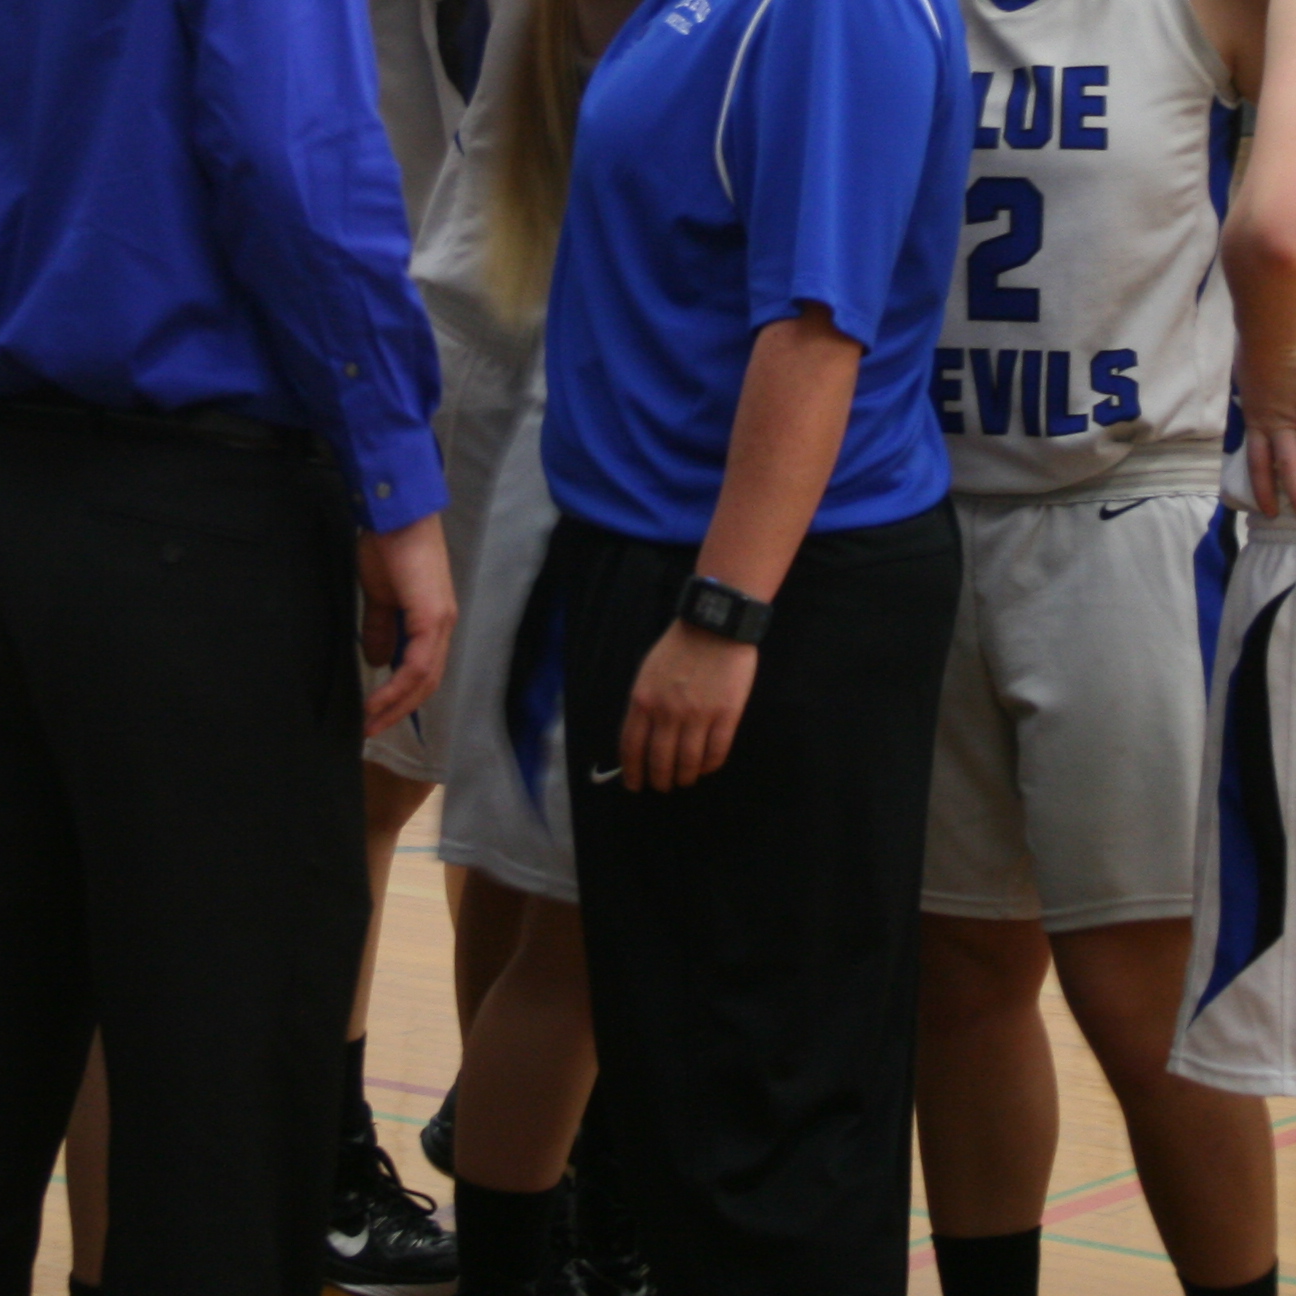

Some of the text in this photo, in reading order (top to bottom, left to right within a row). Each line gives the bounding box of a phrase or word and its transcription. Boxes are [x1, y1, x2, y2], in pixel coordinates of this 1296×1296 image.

[971, 65, 1110, 150] LUE
[965, 176, 1044, 323] 2
[930, 348, 1142, 437] EVILS
